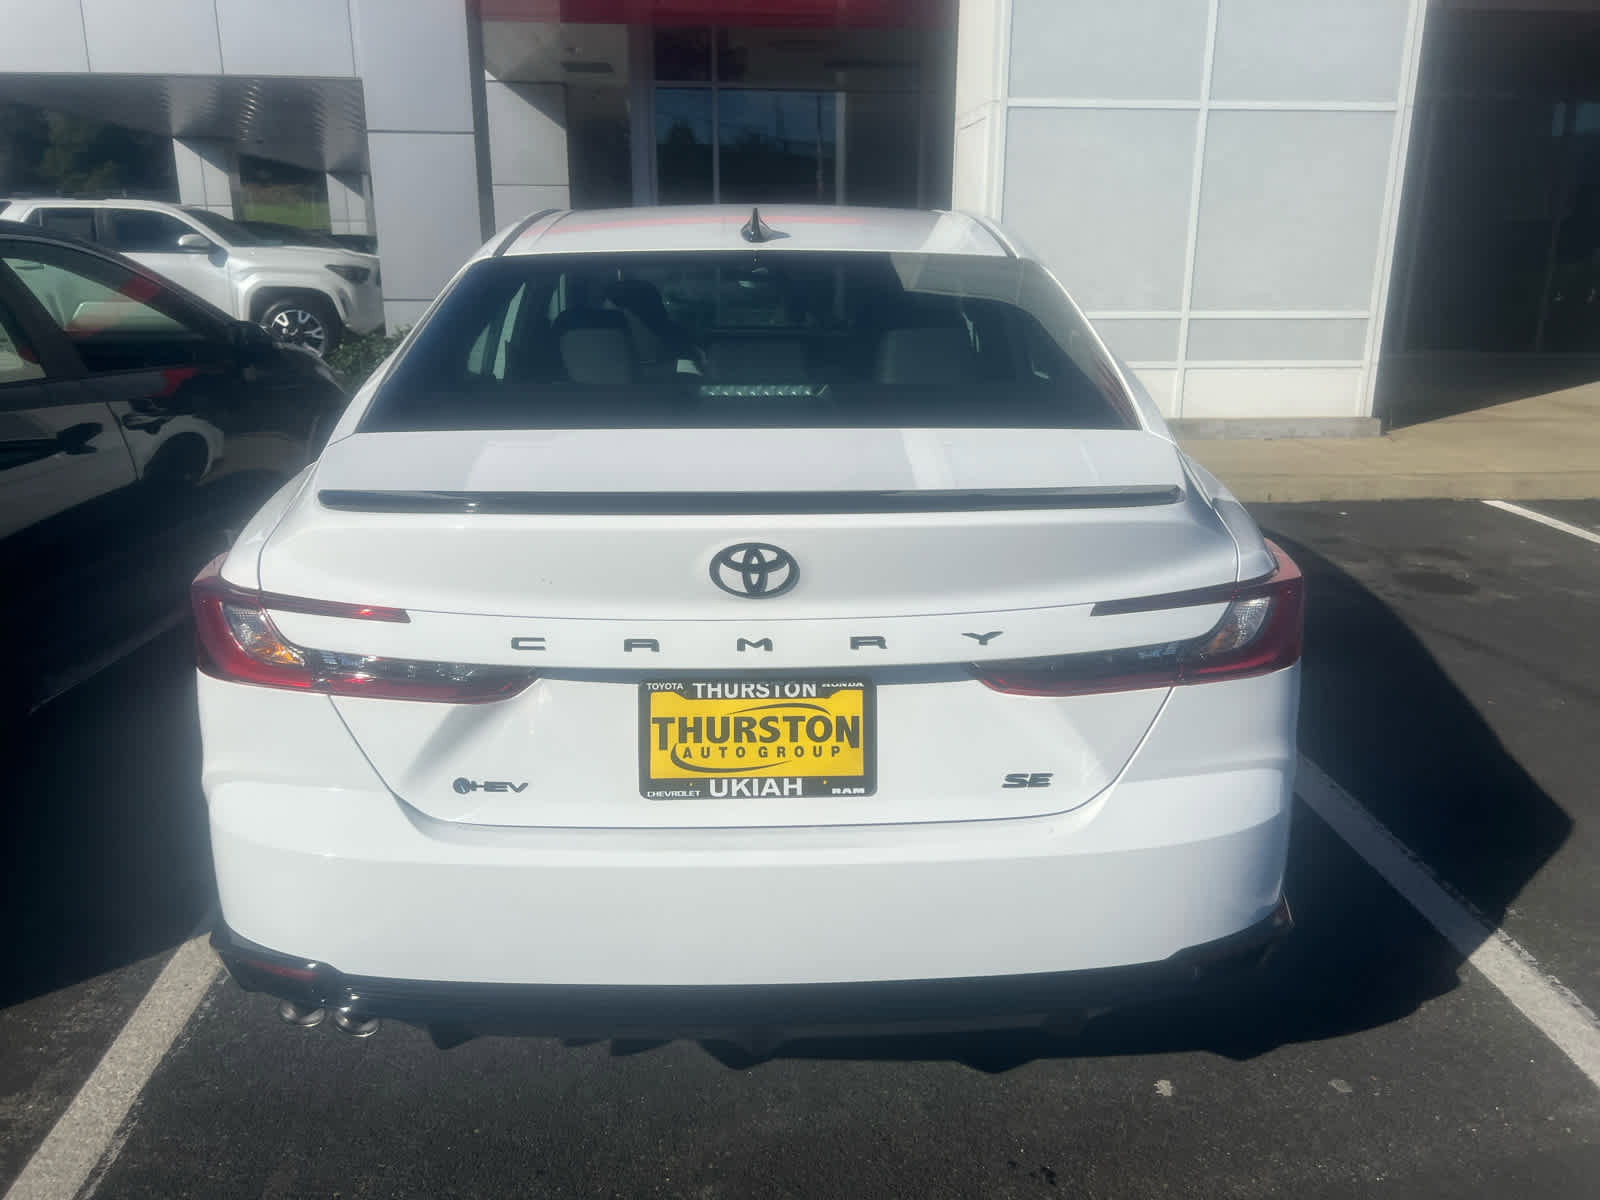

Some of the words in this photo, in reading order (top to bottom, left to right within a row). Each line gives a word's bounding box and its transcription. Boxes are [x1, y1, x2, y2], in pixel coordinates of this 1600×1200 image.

[511, 631, 1004, 652] CAMRY
[647, 682, 684, 691] TOYOTA
[692, 682, 817, 699] THURSTON
[651, 715, 861, 751] THURSTON
[682, 746, 746, 759] AUTO
[758, 745, 841, 758] GROUP
[709, 778, 803, 797] UKIAH
[1001, 773, 1054, 788] SE
[647, 790, 701, 798] CHEVROLET
